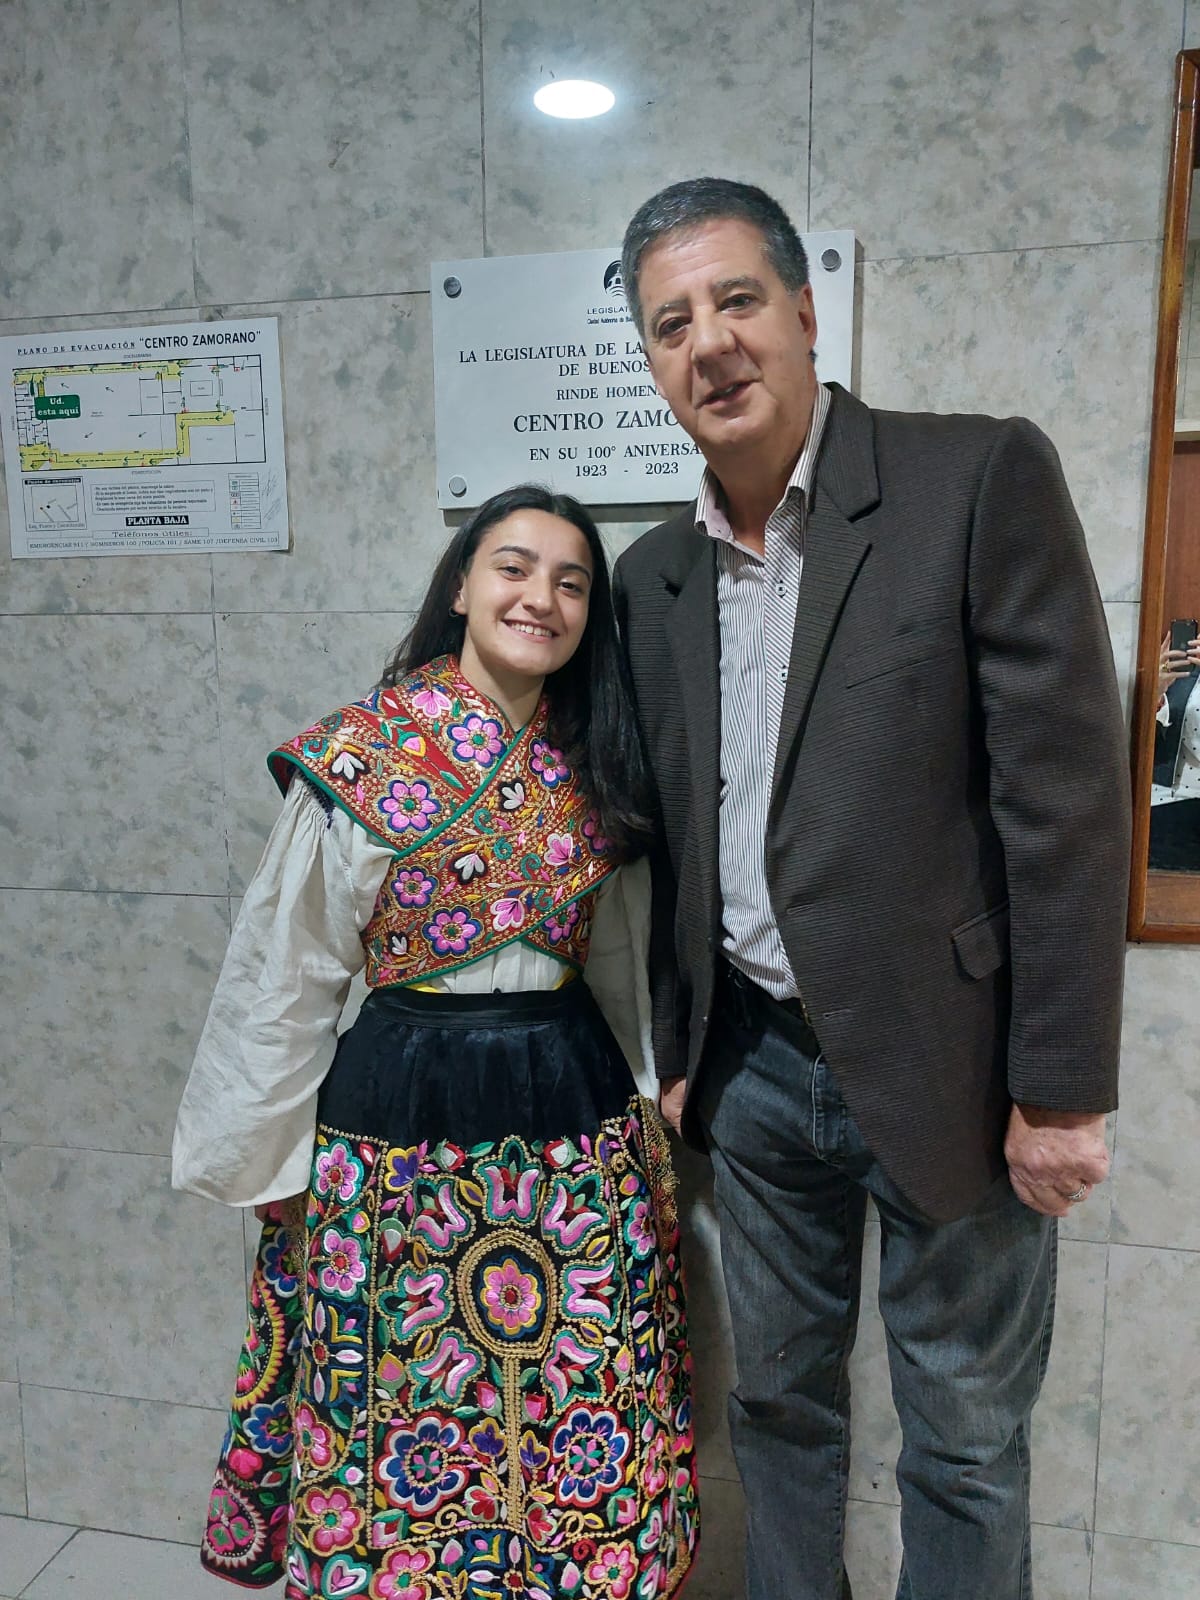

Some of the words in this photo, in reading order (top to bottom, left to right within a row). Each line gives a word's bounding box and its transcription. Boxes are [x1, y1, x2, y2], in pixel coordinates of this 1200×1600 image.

[587, 306, 629, 315] LEGISLAT
[17, 347, 48, 355] PLANO
[53, 345, 65, 353] DE
[71, 341, 135, 351] EVACUACIÓN
[192, 330, 261, 346] ZAMORANO"
[459, 350, 477, 363] LA
[485, 344, 587, 362] LEGISLATURA
[595, 342, 617, 356] DE
[624, 341, 645, 355] LA
[558, 364, 580, 377] DE
[588, 360, 651, 375] BUENOS
[50, 397, 65, 405] Ud.
[556, 387, 599, 401] RINDE
[606, 385, 661, 398] HOMEN
[513, 411, 604, 433] CENTRO
[615, 408, 679, 429] ZAMO
[529, 447, 550, 461] EN
[558, 447, 578, 460] SU
[623, 443, 704, 458] ANIVERSA
[575, 464, 608, 478] 1923
[645, 461, 679, 475] 2023
[127, 517, 162, 525] PLANTA
[163, 516, 187, 524] BAJA
